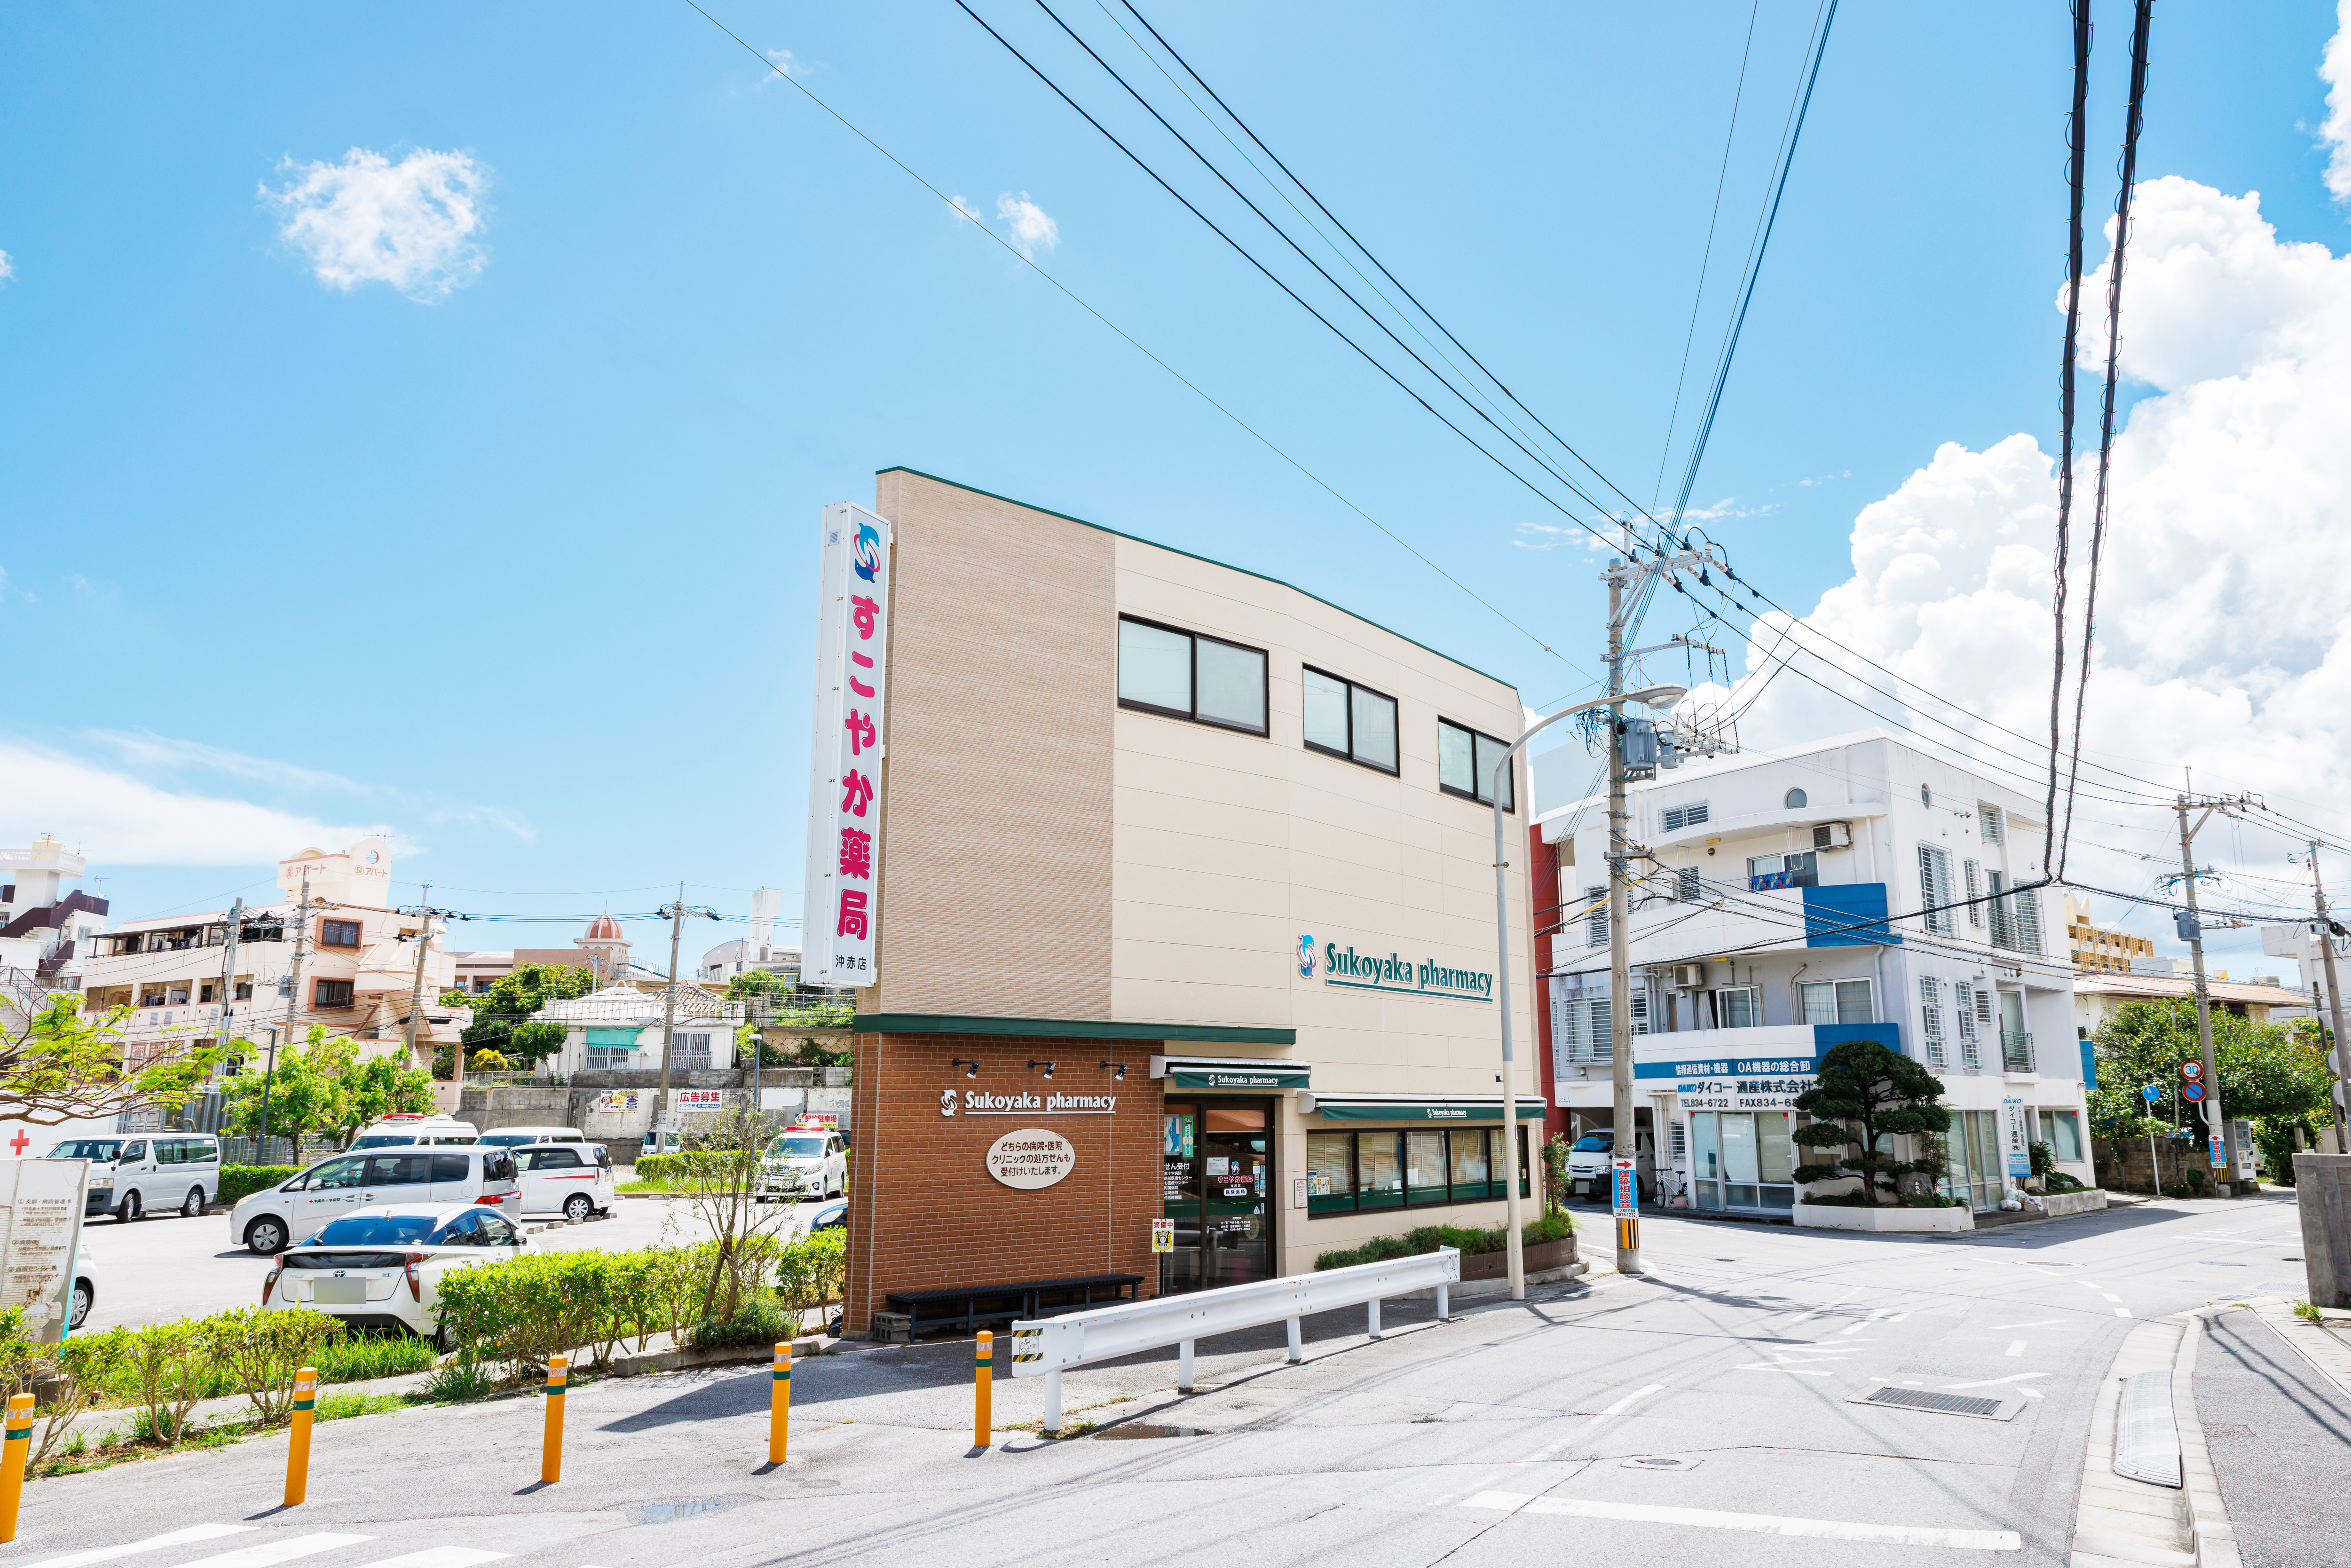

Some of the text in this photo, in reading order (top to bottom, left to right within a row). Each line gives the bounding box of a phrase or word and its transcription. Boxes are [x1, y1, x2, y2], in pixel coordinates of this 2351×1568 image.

[837, 593, 879, 941] すこやか薬局
[836, 954, 867, 970] 沖赤店
[1325, 942, 1493, 997] Sukoyaka pharmacy
[1675, 1060, 1811, 1075] 情報通信資材・機器 OA機器の総合卸
[2185, 1065, 2199, 1075] 30
[1218, 1075, 1278, 1085] Sukoyaka pharmacy
[1677, 1079, 1814, 1094] DAIKO ダイコー 通産株式会社
[679, 1092, 720, 1102] 広告募集
[964, 1091, 1117, 1112] Sukoyaka pharmacy
[1680, 1098, 1797, 1108] TEL834-6722 FAX834-68
[1001, 1141, 1063, 1151] どちらの病院・医院
[992, 1153, 1071, 1164] クリニックの処方せんも
[1000, 1165, 1061, 1177] 受付けいたします。
[1618, 1170, 1631, 1208] 建築相談会
